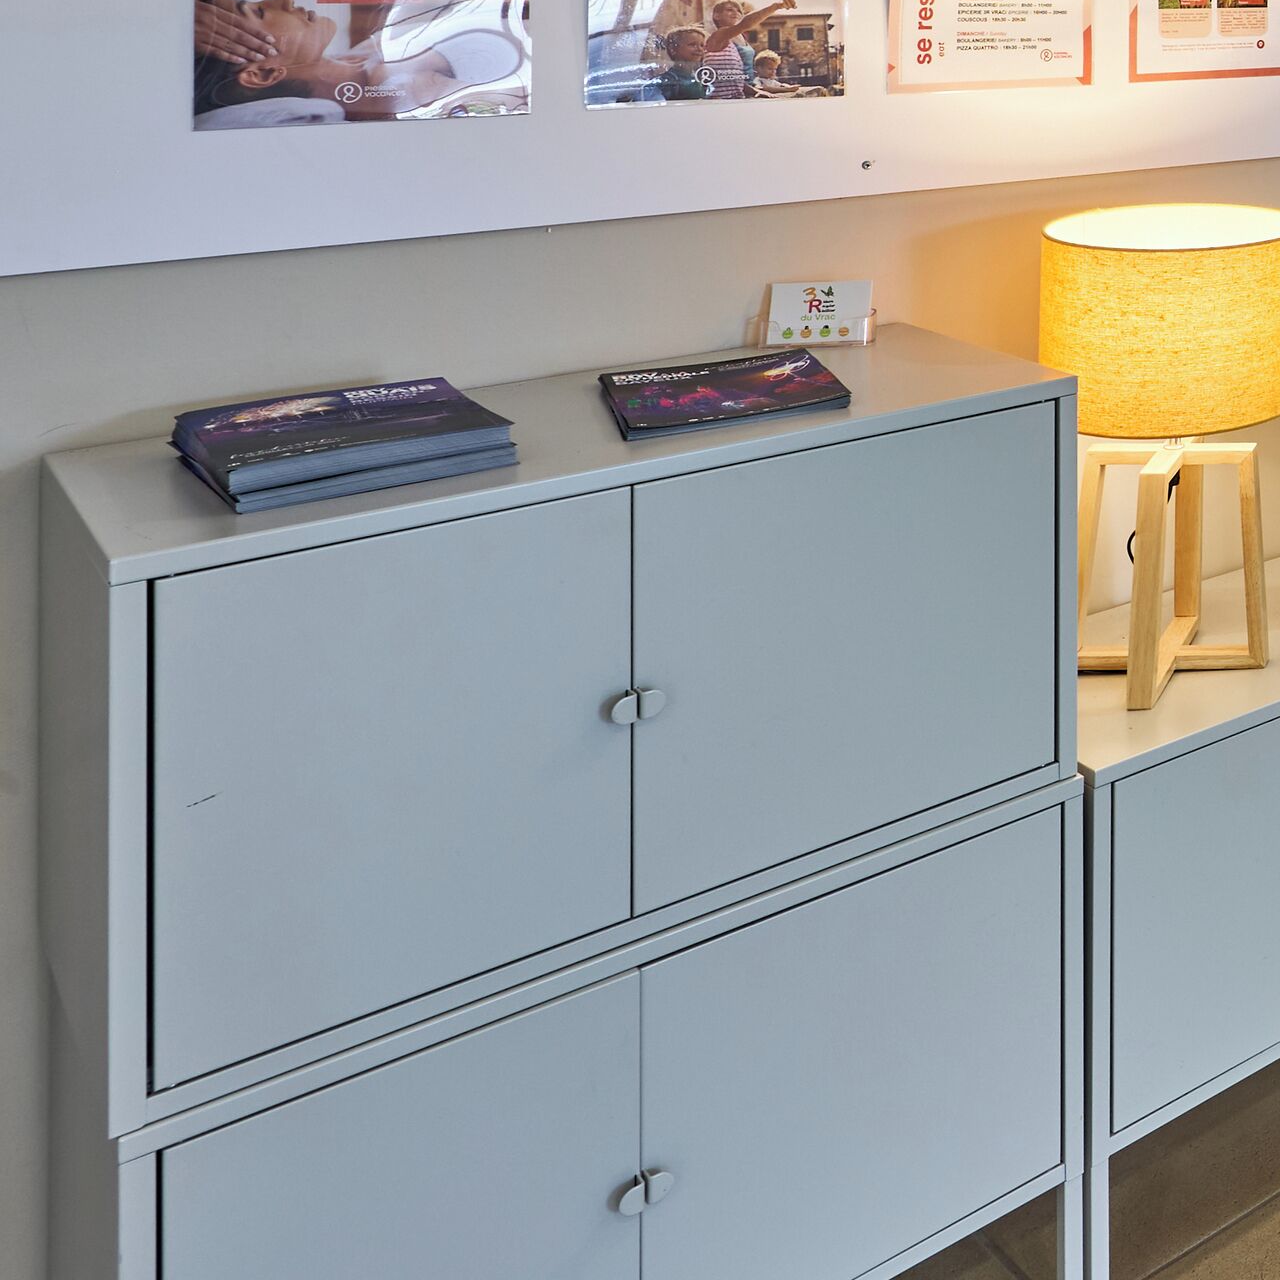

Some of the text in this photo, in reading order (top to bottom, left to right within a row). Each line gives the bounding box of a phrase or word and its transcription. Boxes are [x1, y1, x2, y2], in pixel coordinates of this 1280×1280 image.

[916, 38, 932, 64] se
[803, 287, 816, 303] 3
[808, 299, 822, 313] R
